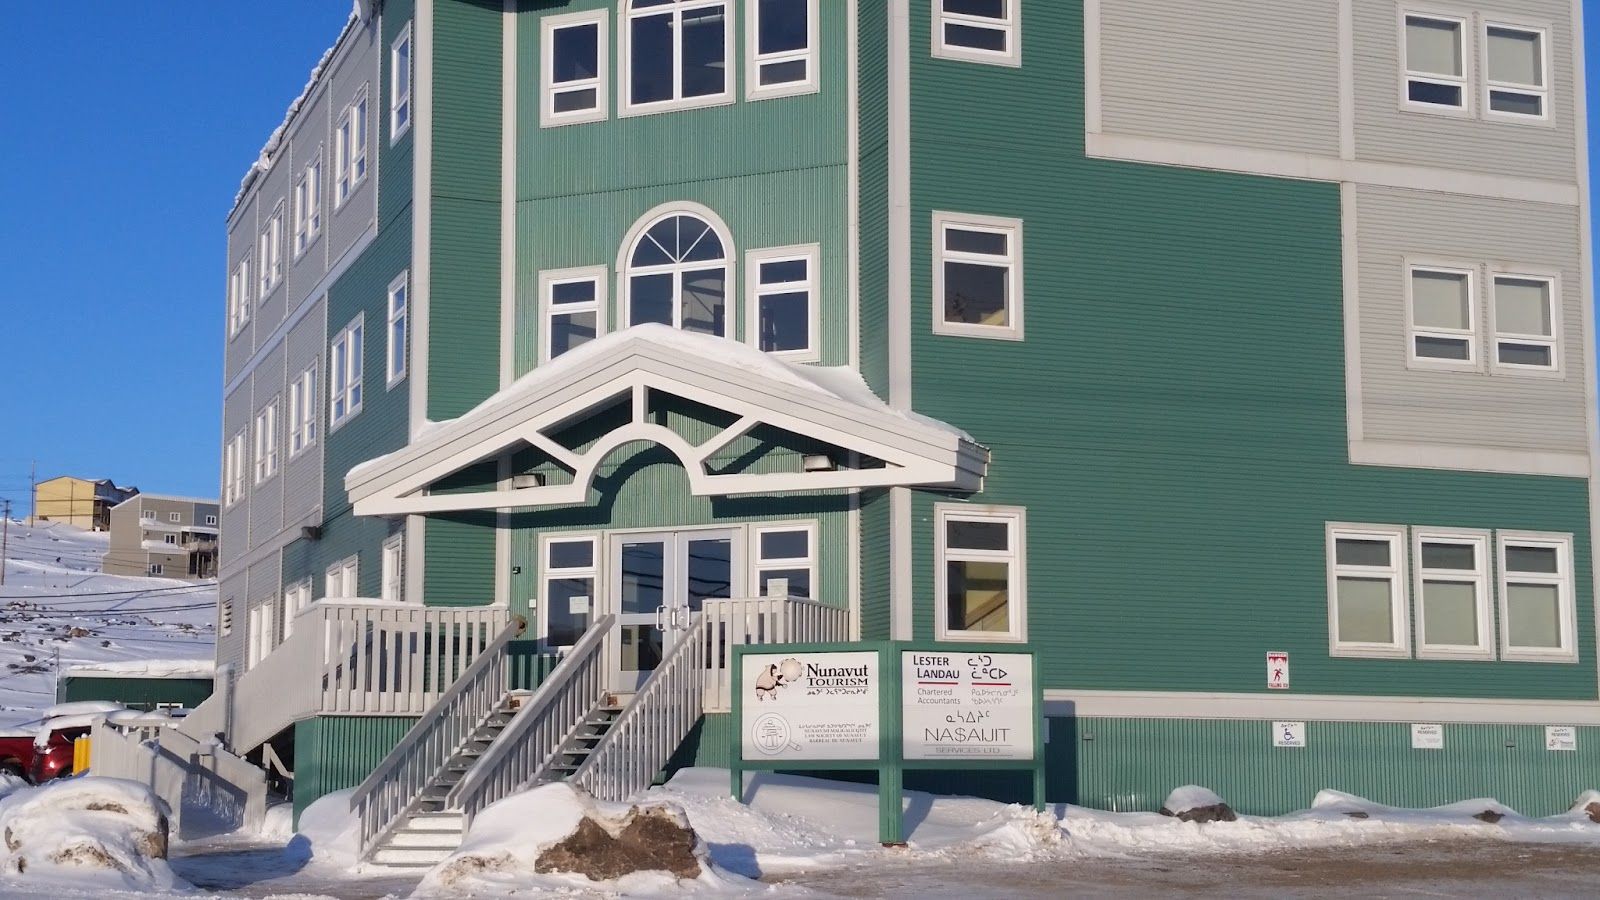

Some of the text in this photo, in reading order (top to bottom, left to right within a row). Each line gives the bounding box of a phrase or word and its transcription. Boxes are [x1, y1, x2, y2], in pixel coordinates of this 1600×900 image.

[913, 655, 949, 666] LESTER
[806, 663, 869, 677] Nunavut
[917, 668, 960, 679] LANDAU
[806, 677, 869, 686] TOURISM
[917, 688, 953, 696] Chartered
[917, 697, 961, 705] Accountants
